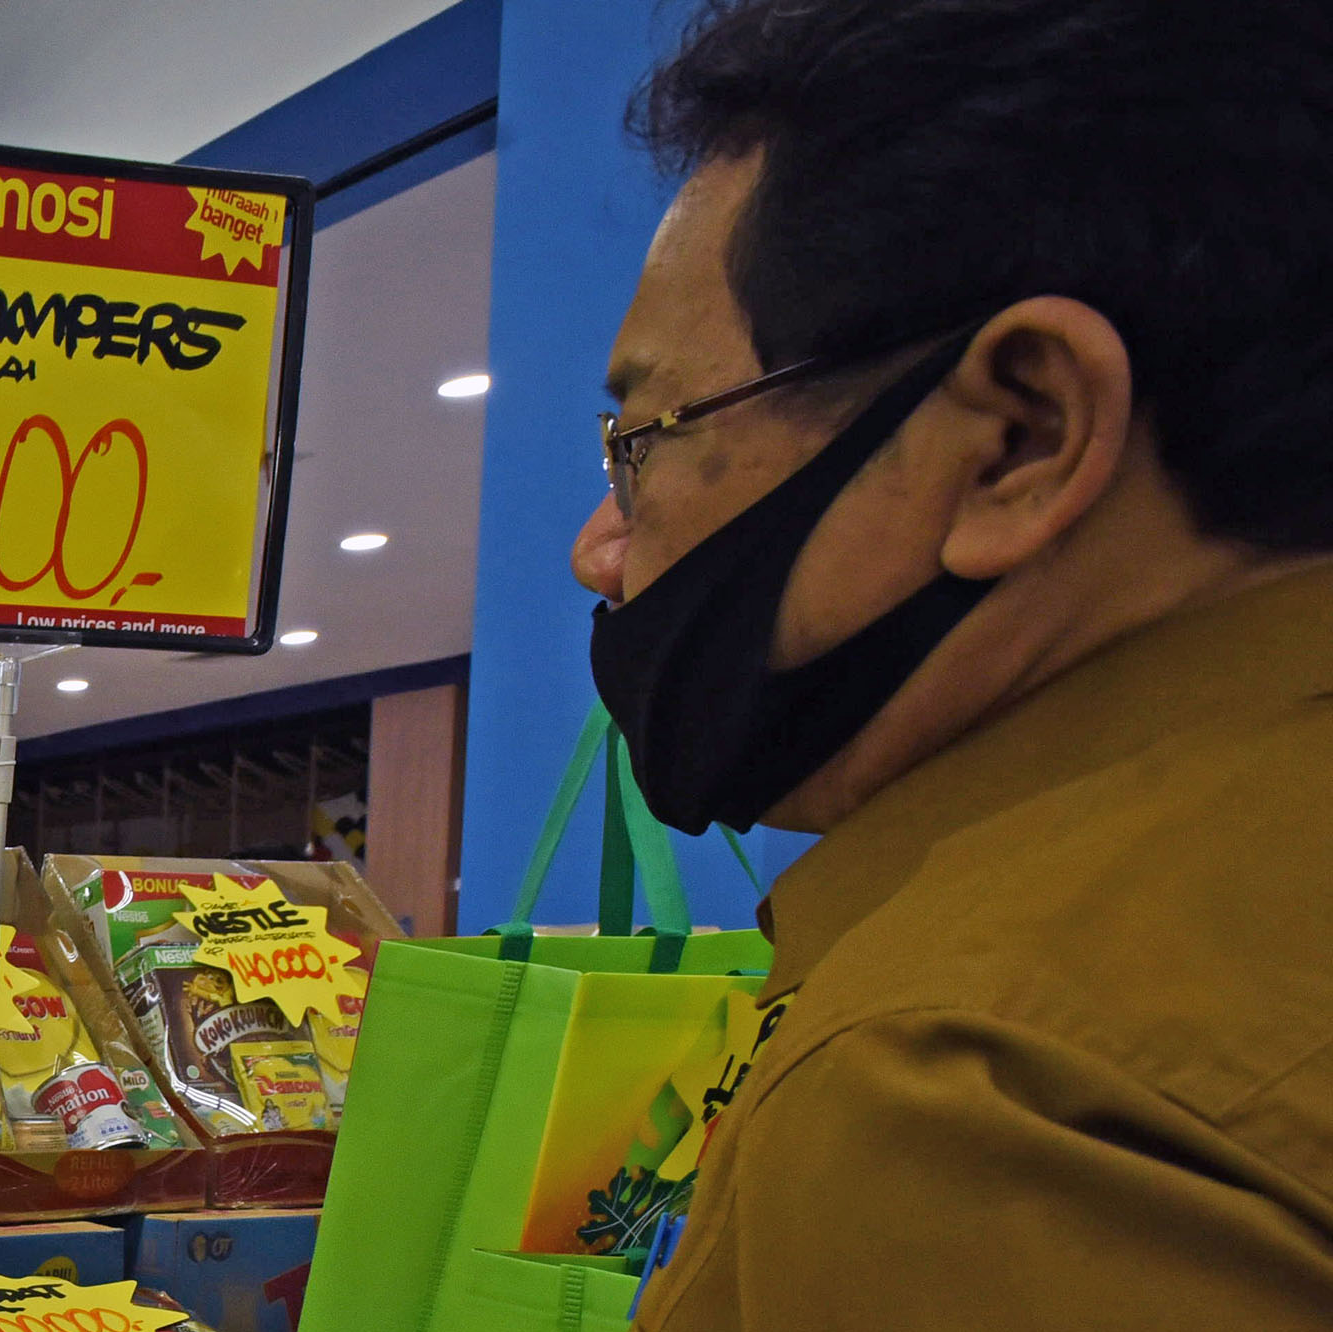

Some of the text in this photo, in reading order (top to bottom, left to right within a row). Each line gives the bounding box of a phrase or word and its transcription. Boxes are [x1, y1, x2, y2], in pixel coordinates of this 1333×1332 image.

[200, 198, 264, 244] banget
[61, 614, 118, 632] prices
[122, 617, 155, 634] and
[193, 900, 309, 938] NESTLE
[122, 1074, 147, 1087] MILO
[70, 1151, 118, 1169] REFILL
